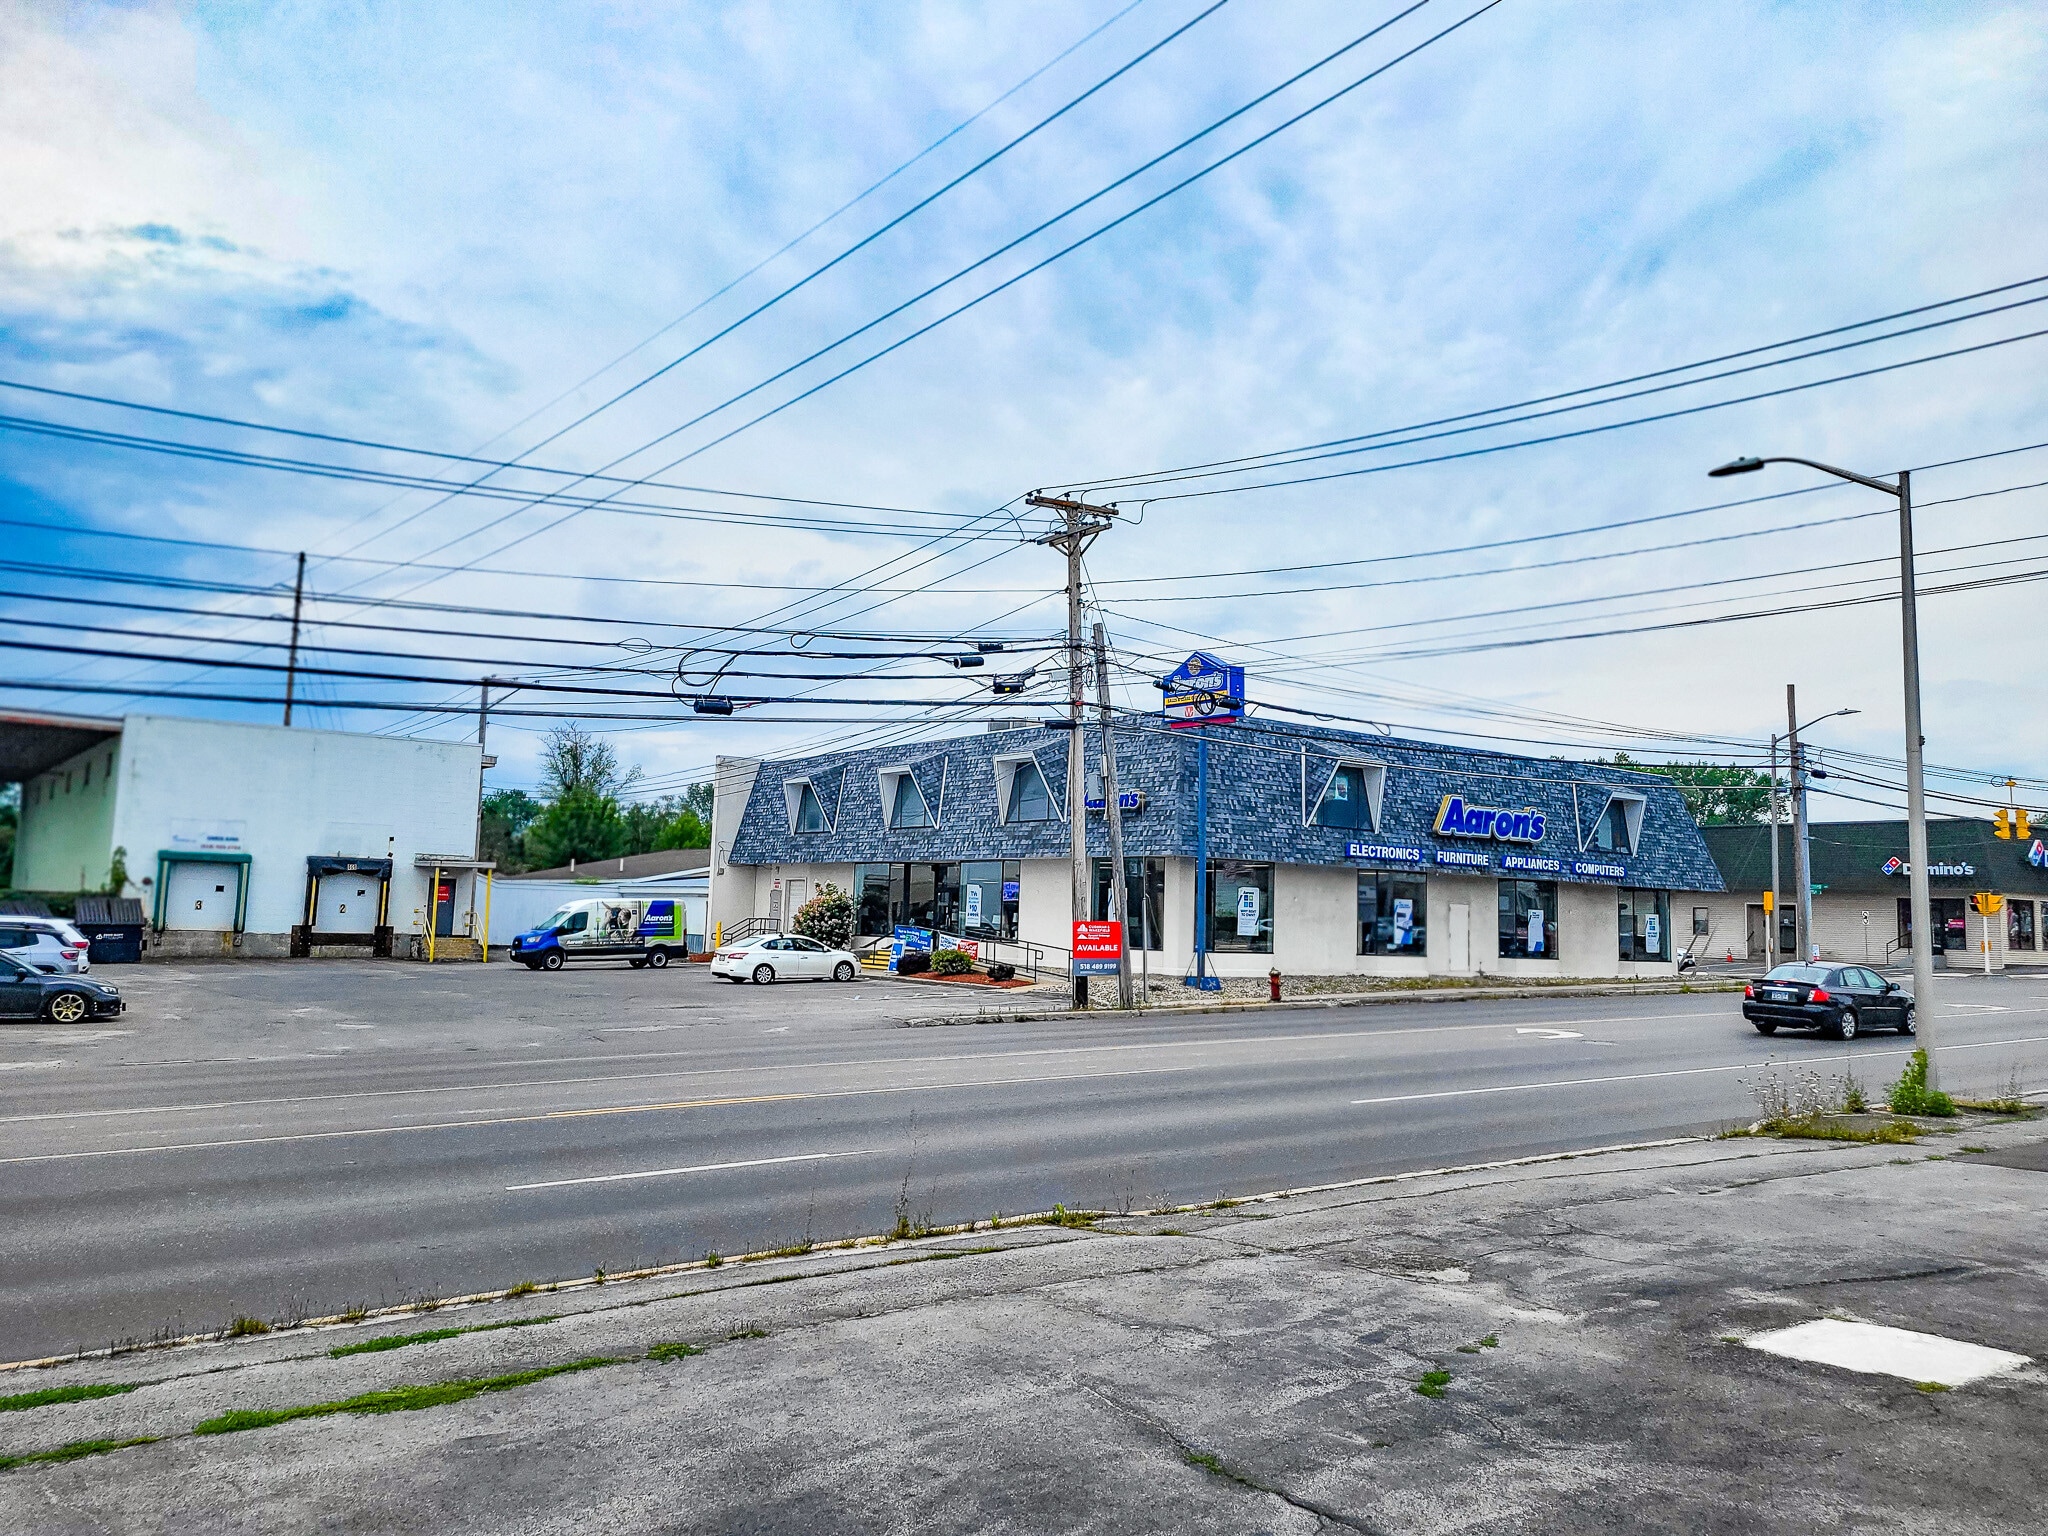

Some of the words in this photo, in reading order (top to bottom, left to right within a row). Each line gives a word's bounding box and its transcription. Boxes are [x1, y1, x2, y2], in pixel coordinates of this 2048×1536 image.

[1441, 796, 1546, 841] Aaron's
[1350, 844, 1420, 861] ELECTRONICS
[1437, 851, 1489, 866] FURNITURE
[1505, 856, 1560, 871] APPLIANCES
[1575, 862, 1625, 877] COMPUTERS
[1902, 862, 1974, 875] Dmino's
[195, 900, 202, 910] 3
[340, 904, 346, 913] 2
